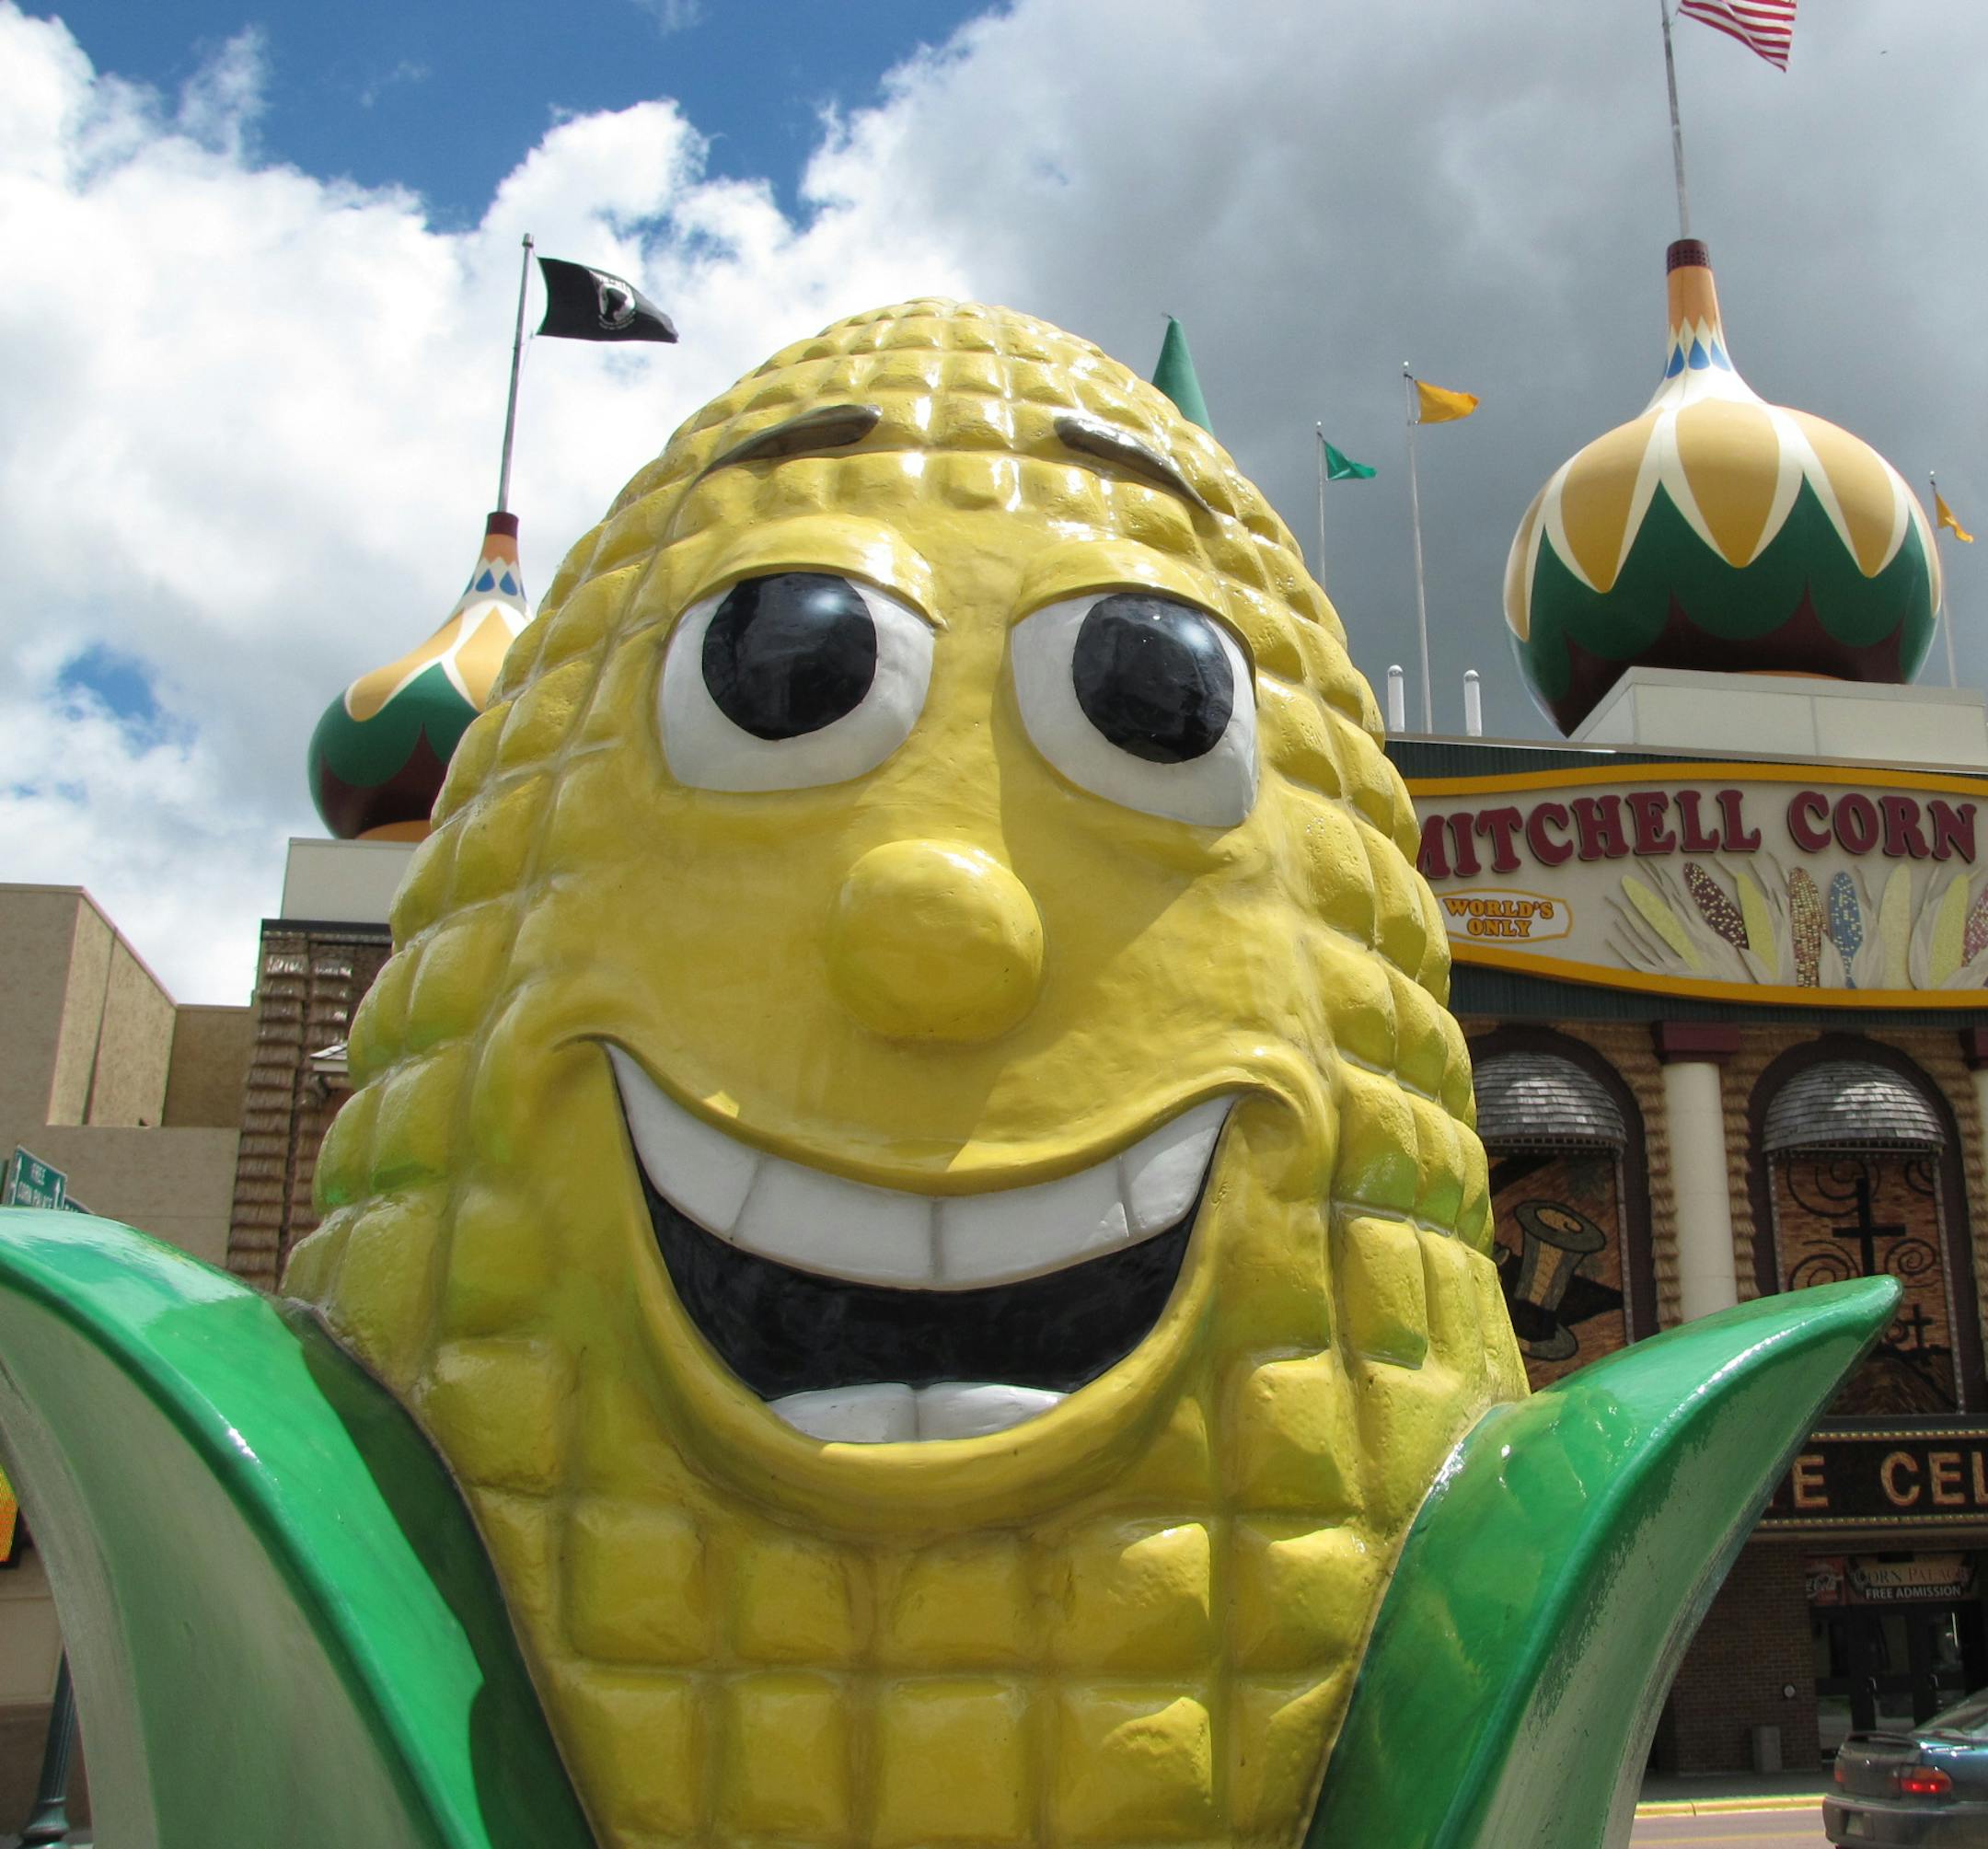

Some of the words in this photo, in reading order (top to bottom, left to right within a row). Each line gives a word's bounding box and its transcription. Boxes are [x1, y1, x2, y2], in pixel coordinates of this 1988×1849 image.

[1788, 791, 1977, 864] CORN
[1442, 897, 1554, 919] WORLD'S
[1466, 918, 1531, 937] ONLY
[1769, 1454, 1829, 1508] E
[1866, 1588, 1893, 1600] FREE
[1896, 1585, 1961, 1599] ADMISSION
